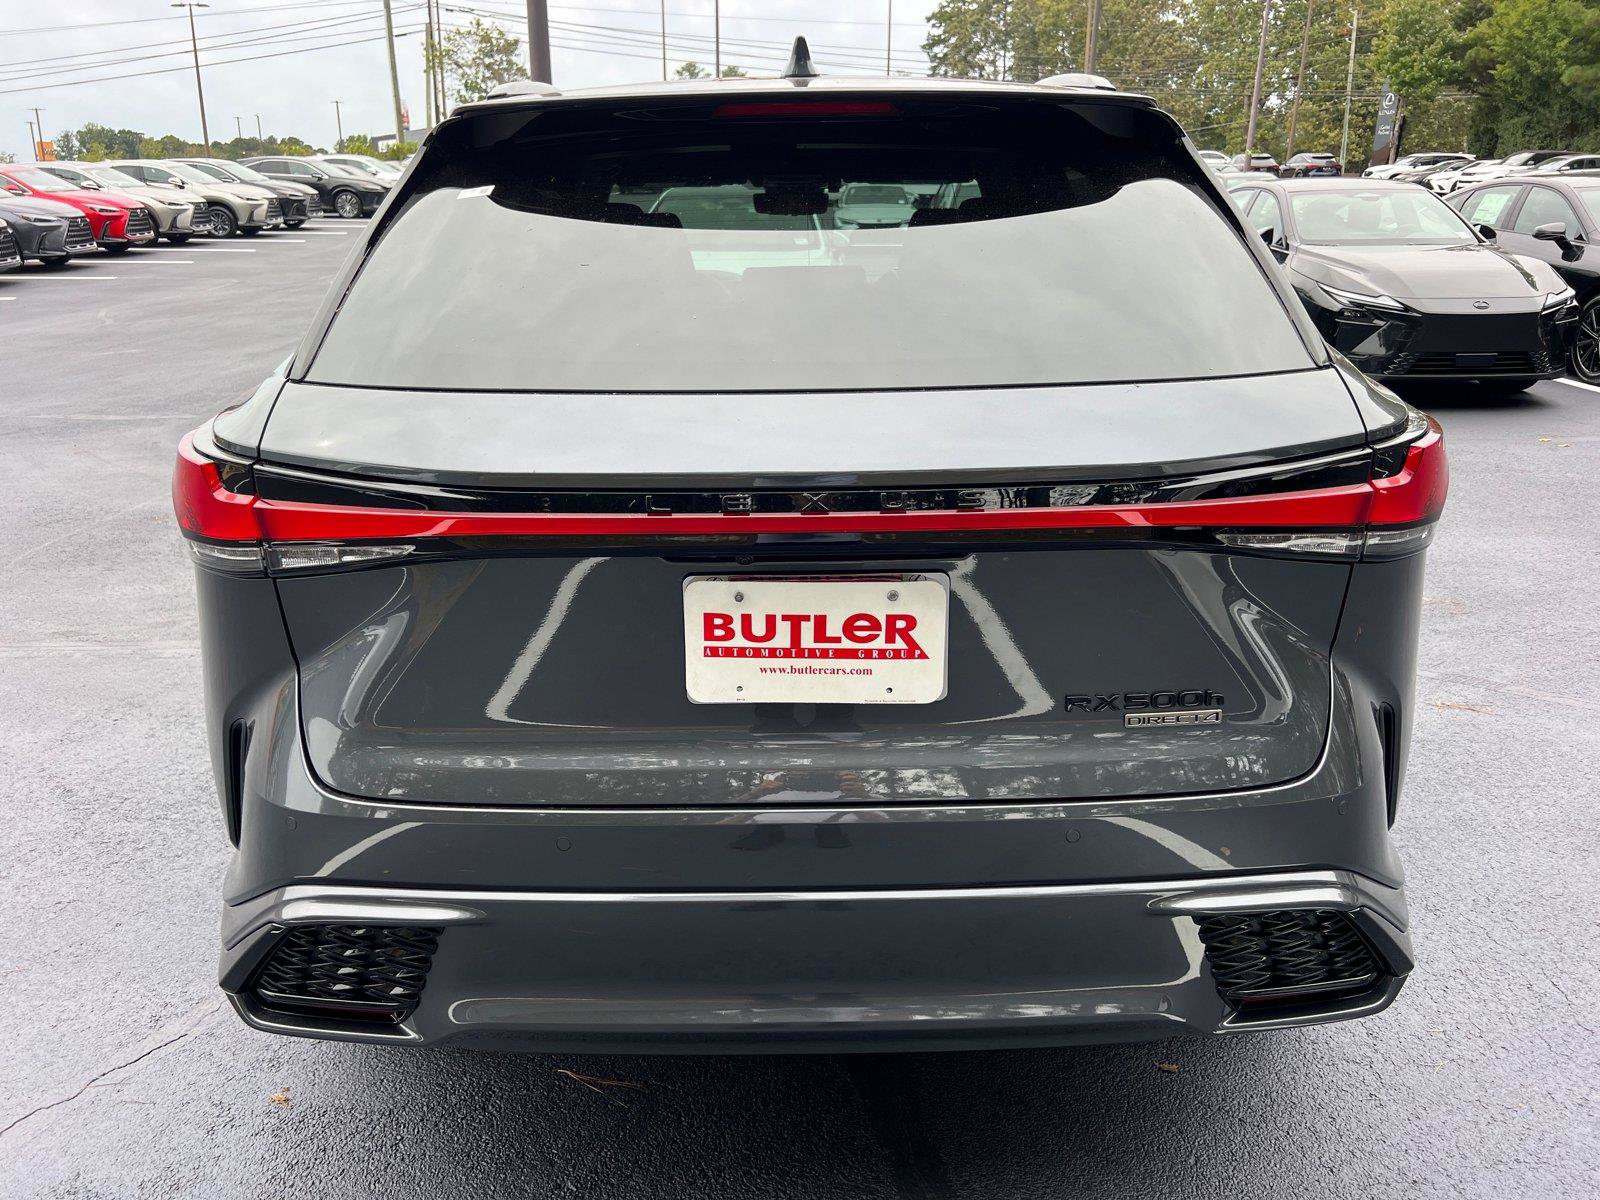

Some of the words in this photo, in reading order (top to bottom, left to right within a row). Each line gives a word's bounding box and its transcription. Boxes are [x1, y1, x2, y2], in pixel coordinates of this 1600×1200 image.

[645, 491, 986, 512] LEXUS
[704, 648, 835, 658] AUTOMOTIVE
[858, 649, 921, 659] GROUP
[759, 665, 873, 677] www.butlercars.com
[1127, 712, 1220, 726] DIRECT4
